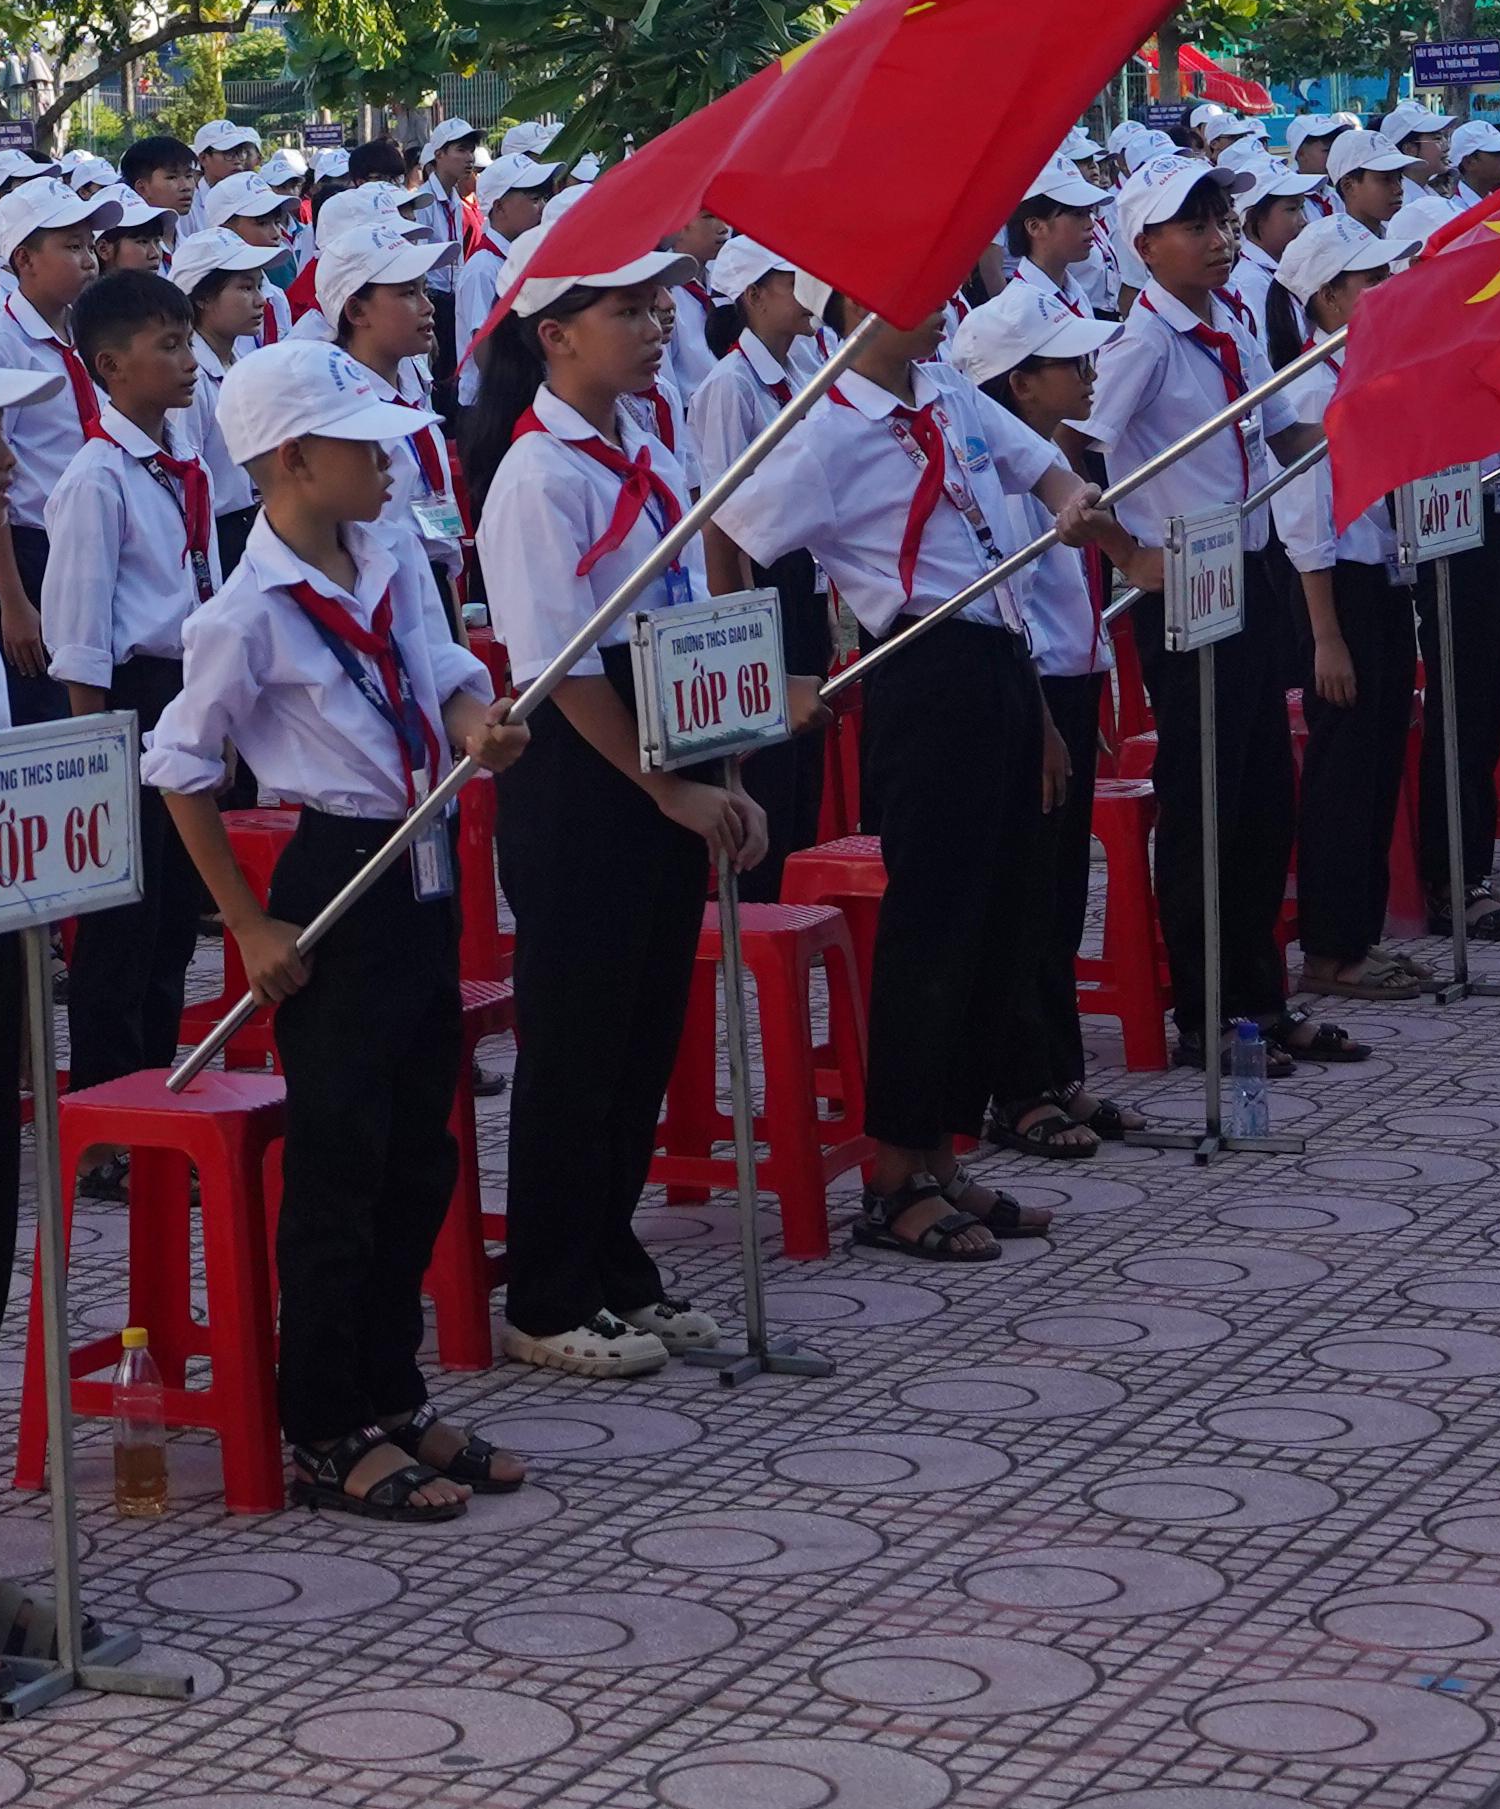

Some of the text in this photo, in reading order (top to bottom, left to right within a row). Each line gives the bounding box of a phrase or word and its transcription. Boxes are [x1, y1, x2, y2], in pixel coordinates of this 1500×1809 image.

[1419, 483, 1472, 538] LỚP 7C
[1190, 559, 1235, 622] LỚP 6A
[672, 632, 704, 655] TRƯỜNG
[705, 629, 726, 648] THCS
[728, 625, 747, 644] GIAO
[673, 658, 771, 734] LỚP 6B
[21, 763, 53, 786] THCS
[57, 756, 85, 781] GIAO
[88, 745, 109, 775] HẢI
[64, 799, 112, 874] 6C
